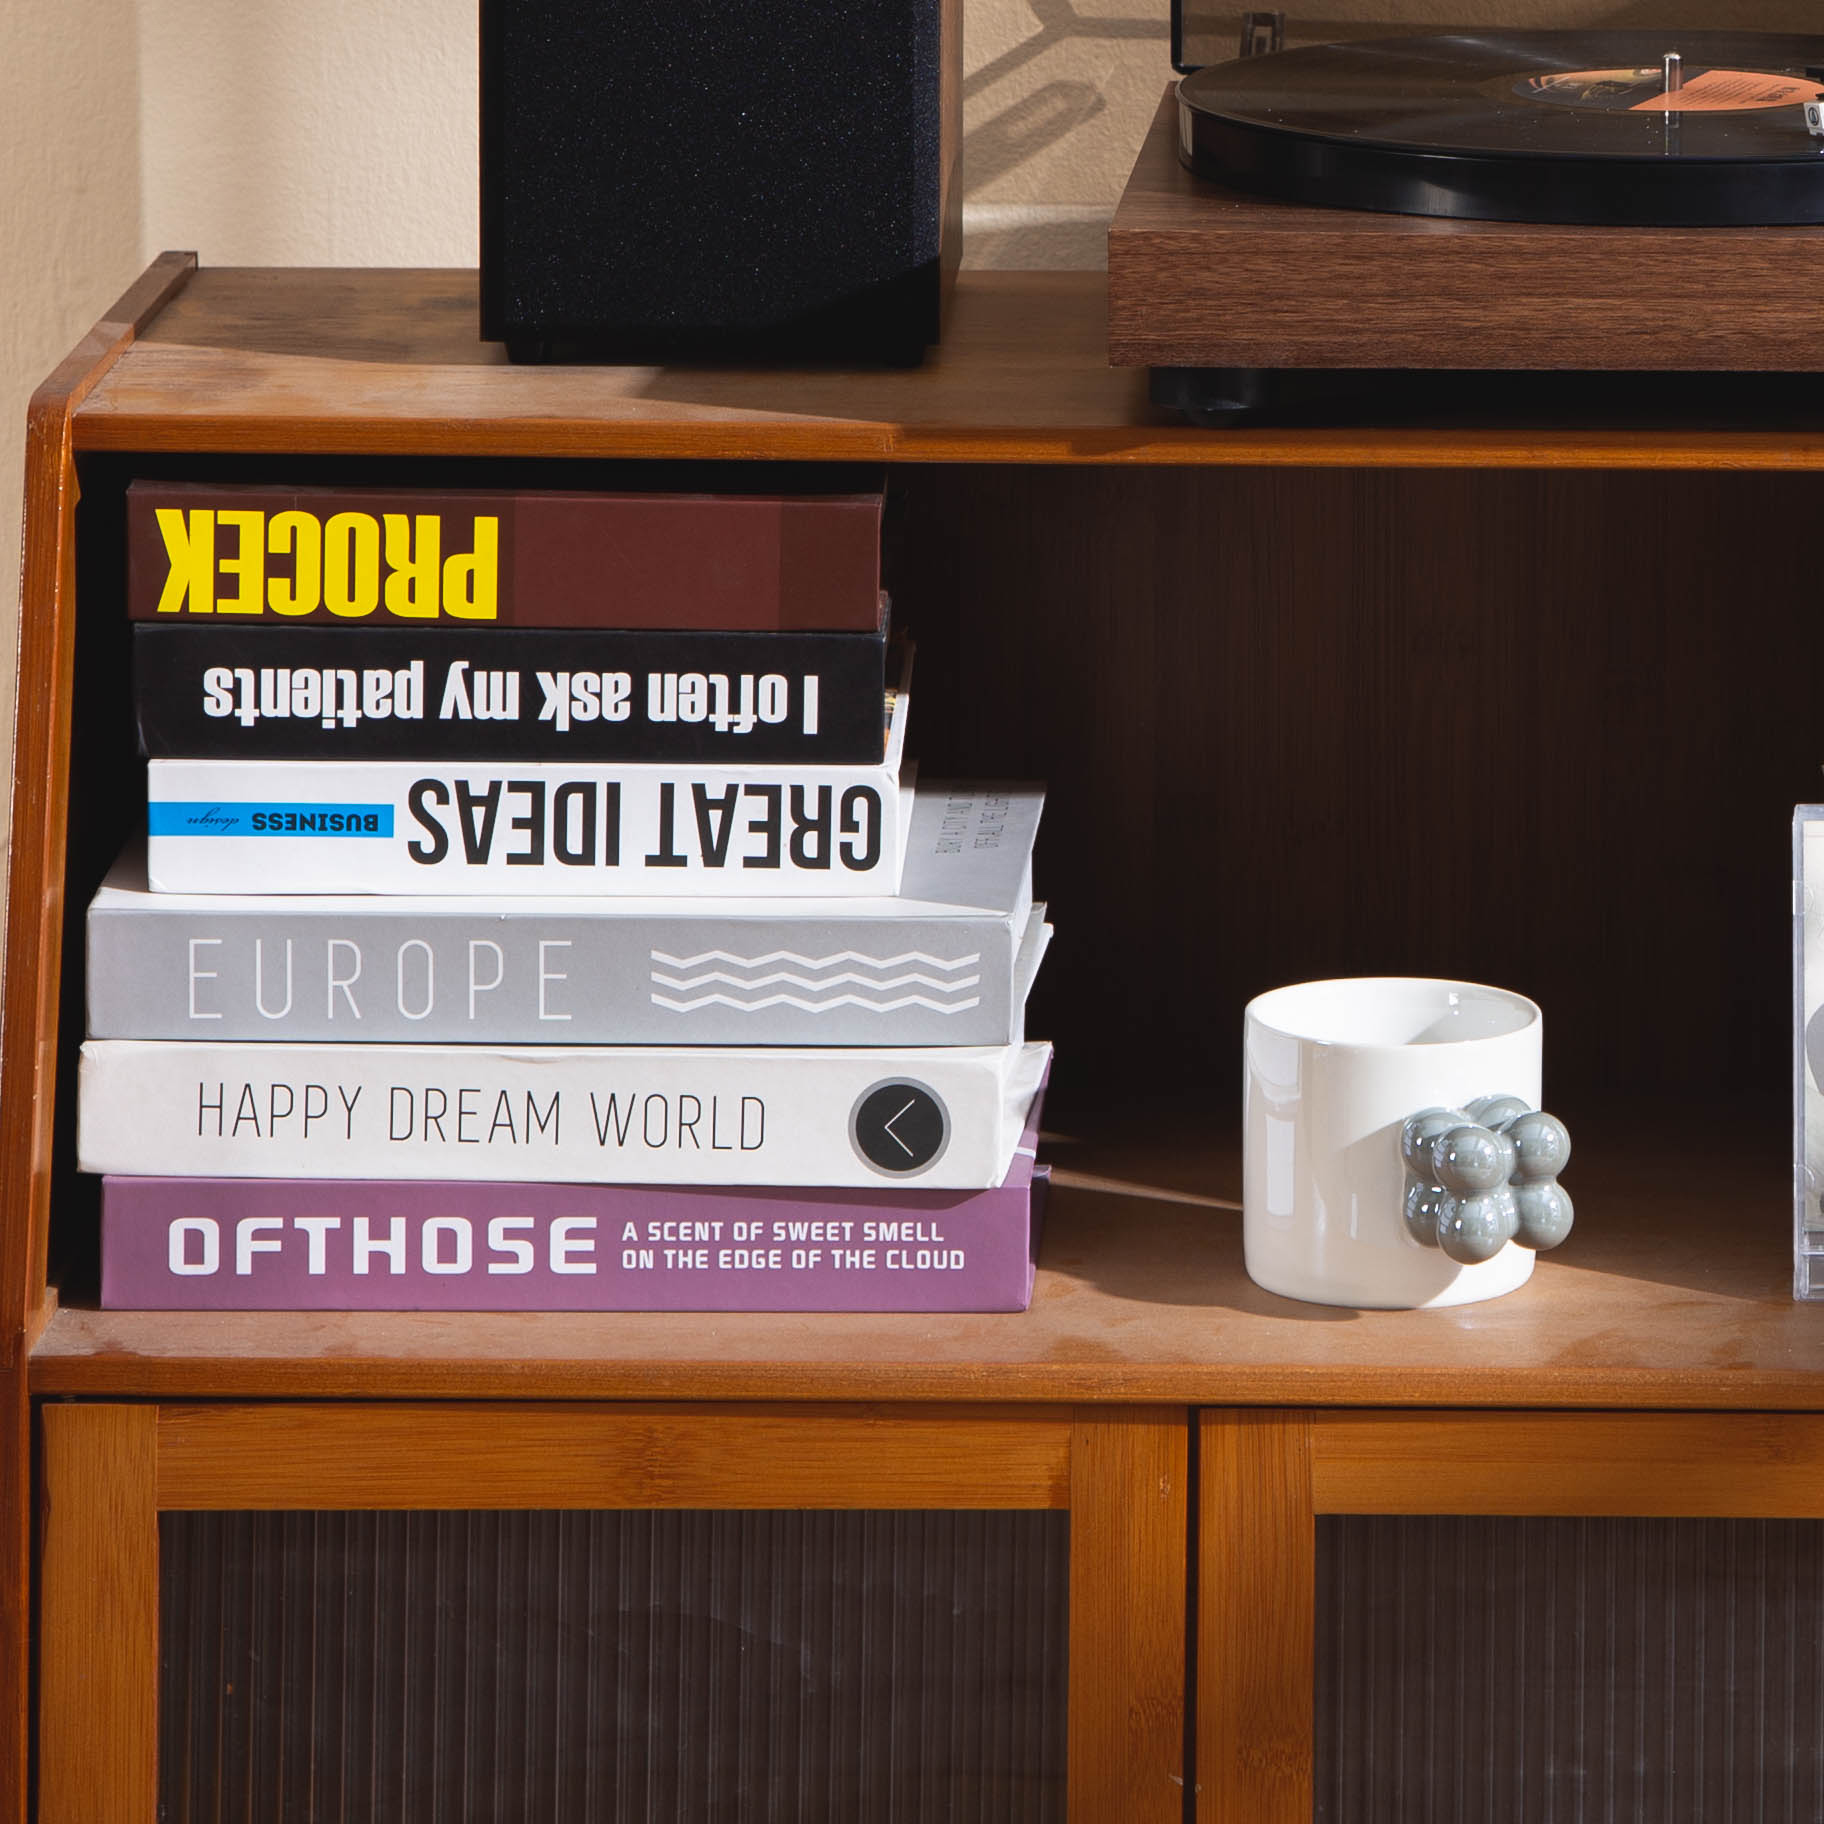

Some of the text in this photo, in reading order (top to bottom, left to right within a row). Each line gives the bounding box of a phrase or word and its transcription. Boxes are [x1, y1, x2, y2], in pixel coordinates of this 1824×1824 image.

[154, 508, 499, 620] PROCEK
[203, 659, 819, 735] I often ask my patients
[187, 807, 379, 832] BUSINESS design
[407, 778, 621, 867] IDEAS
[644, 782, 882, 872] GREAT
[189, 938, 572, 1021] EUROPE
[198, 1081, 765, 1151] HAPPY DREAM WORLD
[168, 1216, 598, 1276] OFTHOSE
[621, 1221, 945, 1242] A SCENT OF SWEET SMELL
[622, 1249, 965, 1270] ON THE EDGE OF THE CLOUD
